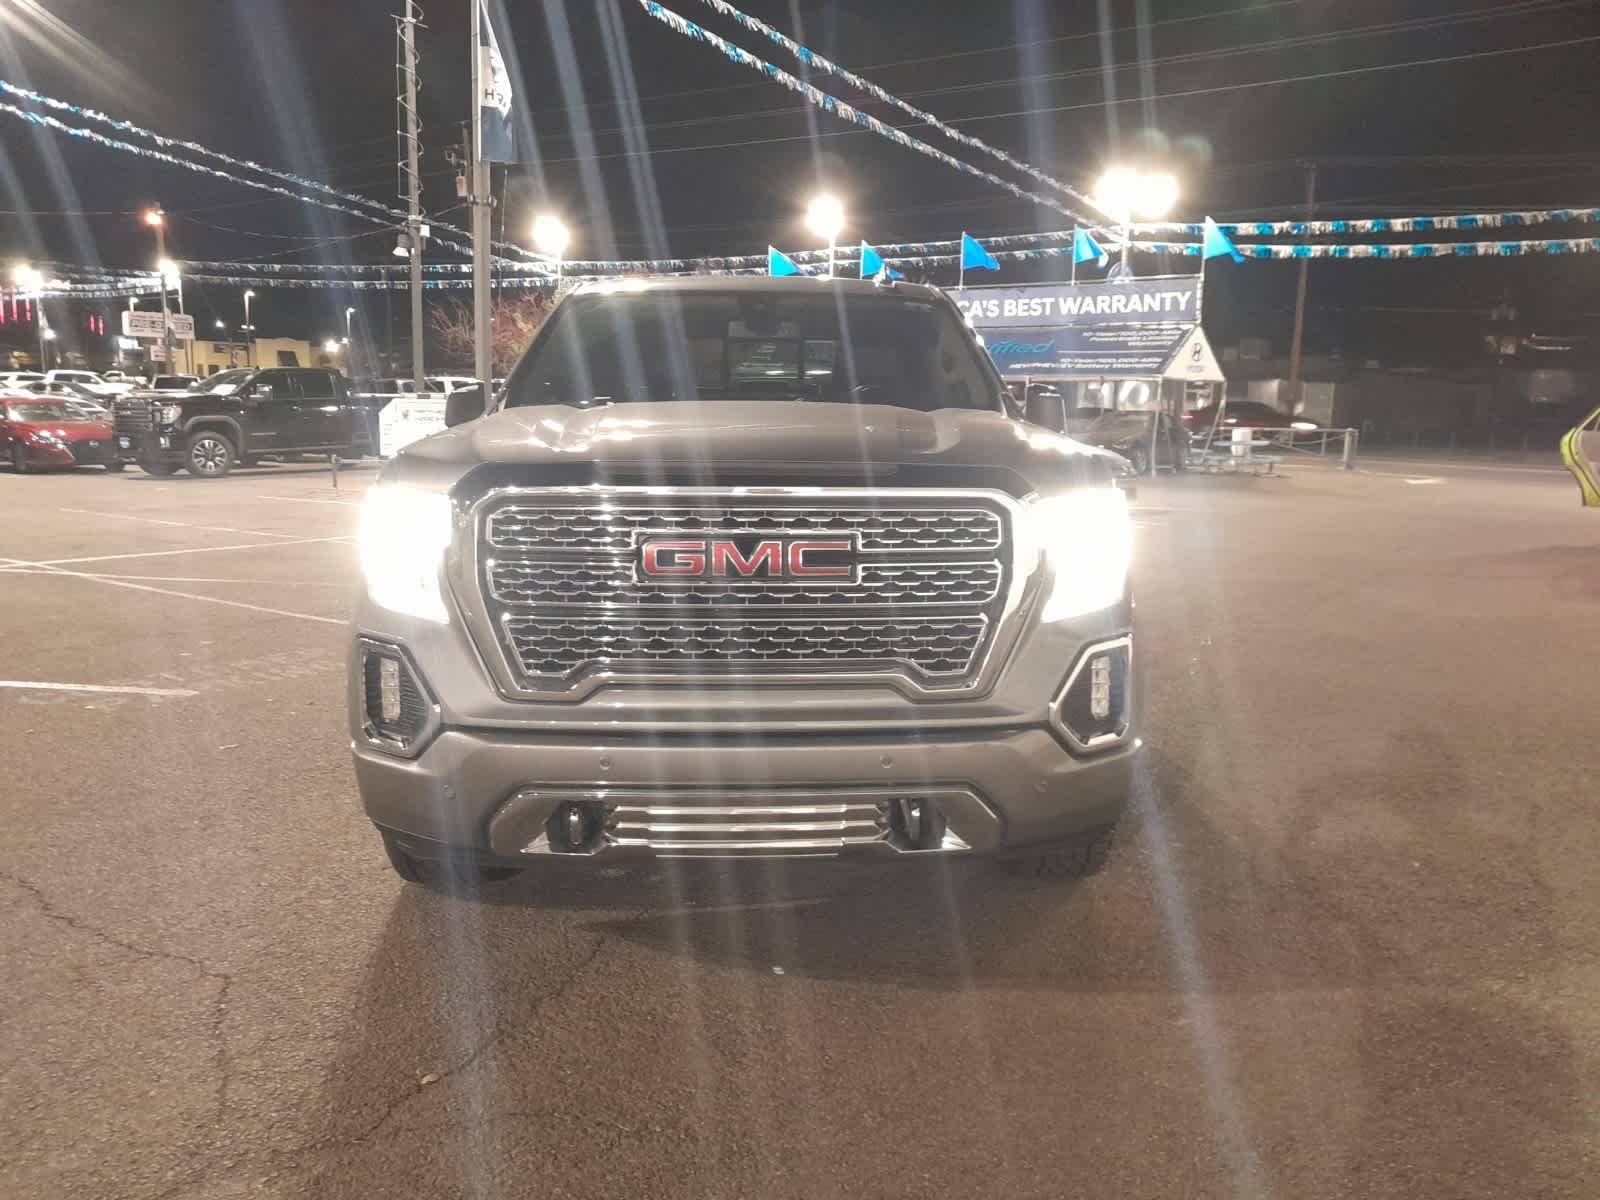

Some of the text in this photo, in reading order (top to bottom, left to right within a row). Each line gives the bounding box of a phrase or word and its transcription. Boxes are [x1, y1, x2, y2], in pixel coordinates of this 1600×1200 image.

[1003, 297, 1056, 317] BEST
[1058, 291, 1193, 315] WARRANTY
[642, 540, 852, 577] GMC
